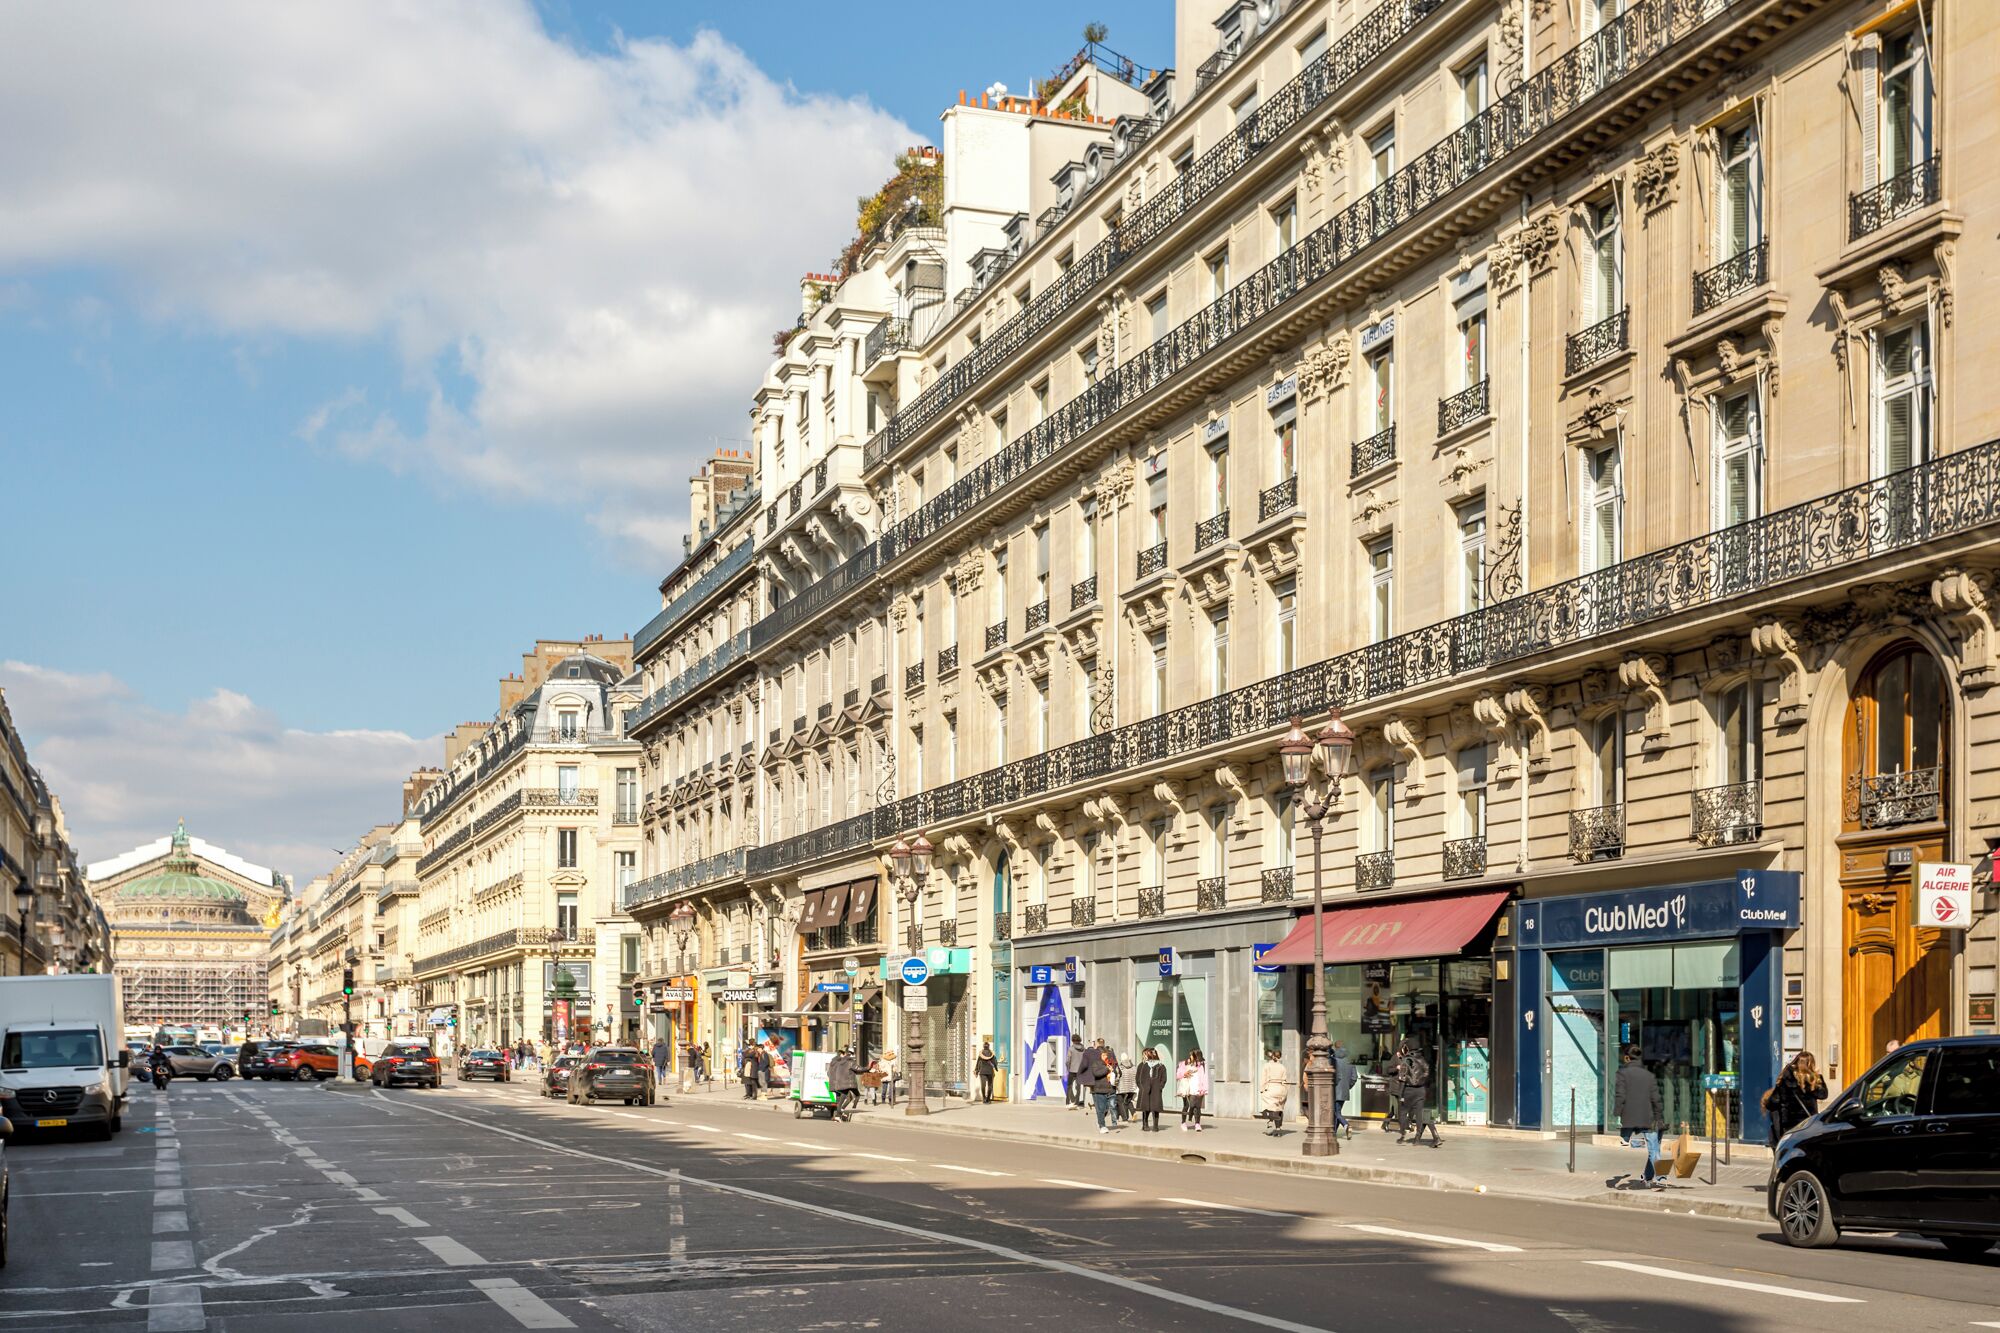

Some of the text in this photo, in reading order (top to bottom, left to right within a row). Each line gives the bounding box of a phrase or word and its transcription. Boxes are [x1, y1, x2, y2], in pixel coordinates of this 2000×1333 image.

[1361, 318, 1395, 348] AIRLINES
[1267, 378, 1296, 404] EASTERN
[1207, 420, 1225, 438] CHINA
[1936, 867, 1956, 877] AIR
[1922, 881, 1970, 891] ALGERIE
[1585, 901, 1669, 934] Club Med
[1740, 909, 1787, 921] Club Med
[1525, 918, 1535, 930] 18
[845, 960, 858, 968] BUS
[1159, 954, 1172, 964] LCL
[1065, 962, 1076, 972] LCL
[724, 990, 756, 1001] CHANGE
